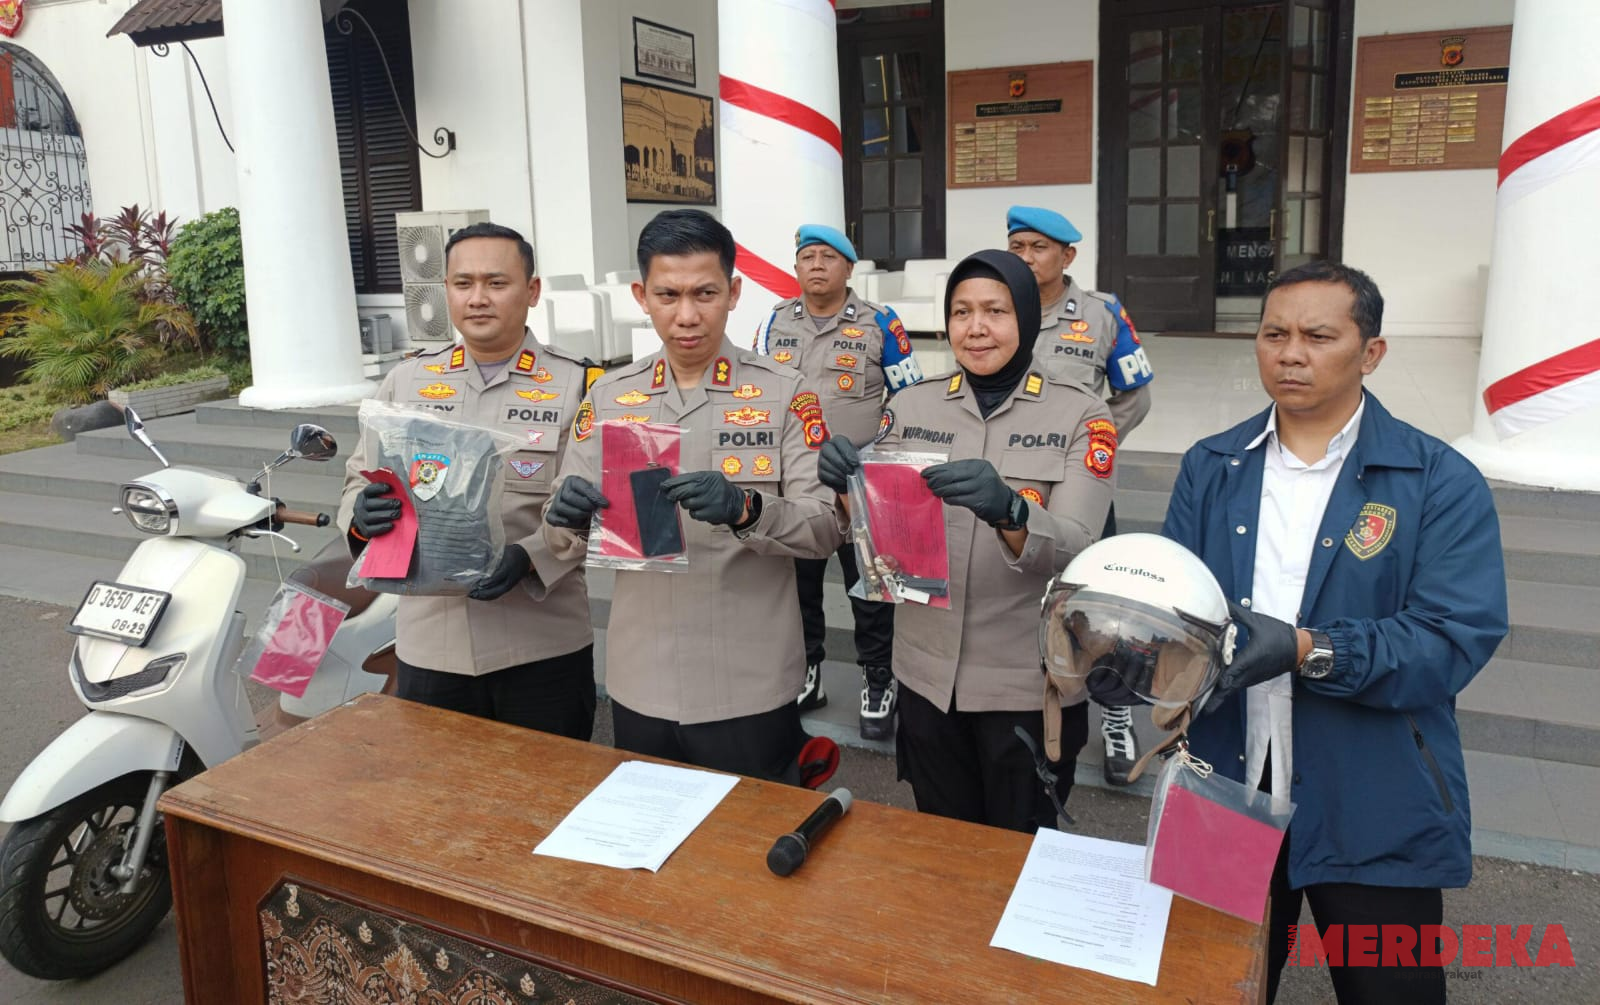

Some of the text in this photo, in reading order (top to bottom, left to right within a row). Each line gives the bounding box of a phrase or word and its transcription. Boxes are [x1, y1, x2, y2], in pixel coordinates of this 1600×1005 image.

[775, 339, 798, 348] ADE
[833, 340, 867, 351] POLRI
[1054, 345, 1094, 359] POLRI
[507, 408, 559, 423] POLRI
[719, 431, 774, 447] POLRI
[902, 426, 954, 444] NURINDAH
[1008, 433, 1067, 448] POLRI
[1103, 563, 1165, 582] Cargloss
[88, 588, 99, 605] D
[100, 590, 132, 610] 3650
